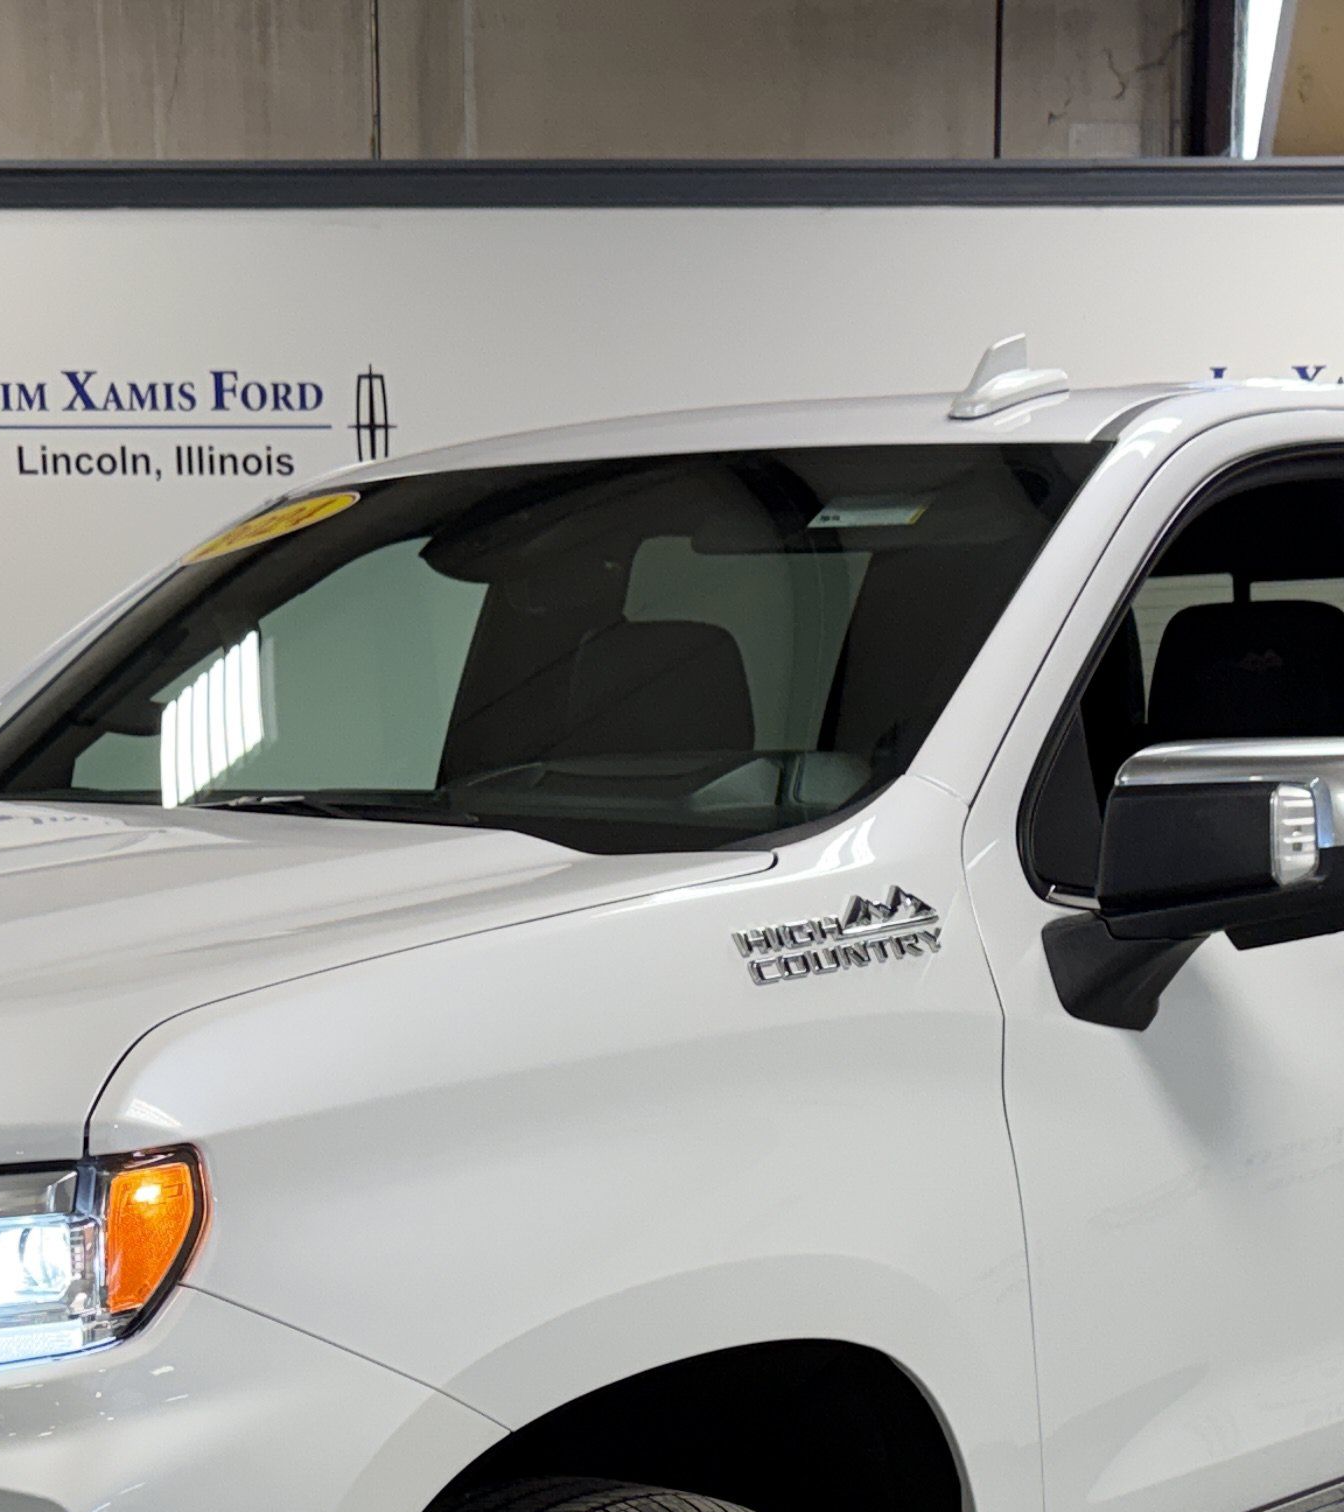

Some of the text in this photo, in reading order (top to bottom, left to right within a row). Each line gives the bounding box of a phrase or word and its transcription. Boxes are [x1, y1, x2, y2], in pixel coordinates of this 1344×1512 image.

[60, 370, 197, 412] XAMIS
[210, 370, 325, 412] FORD
[17, 445, 296, 480] Lincoln, Illinois
[731, 914, 844, 958] HIGH
[747, 927, 942, 986] COUNTRY
